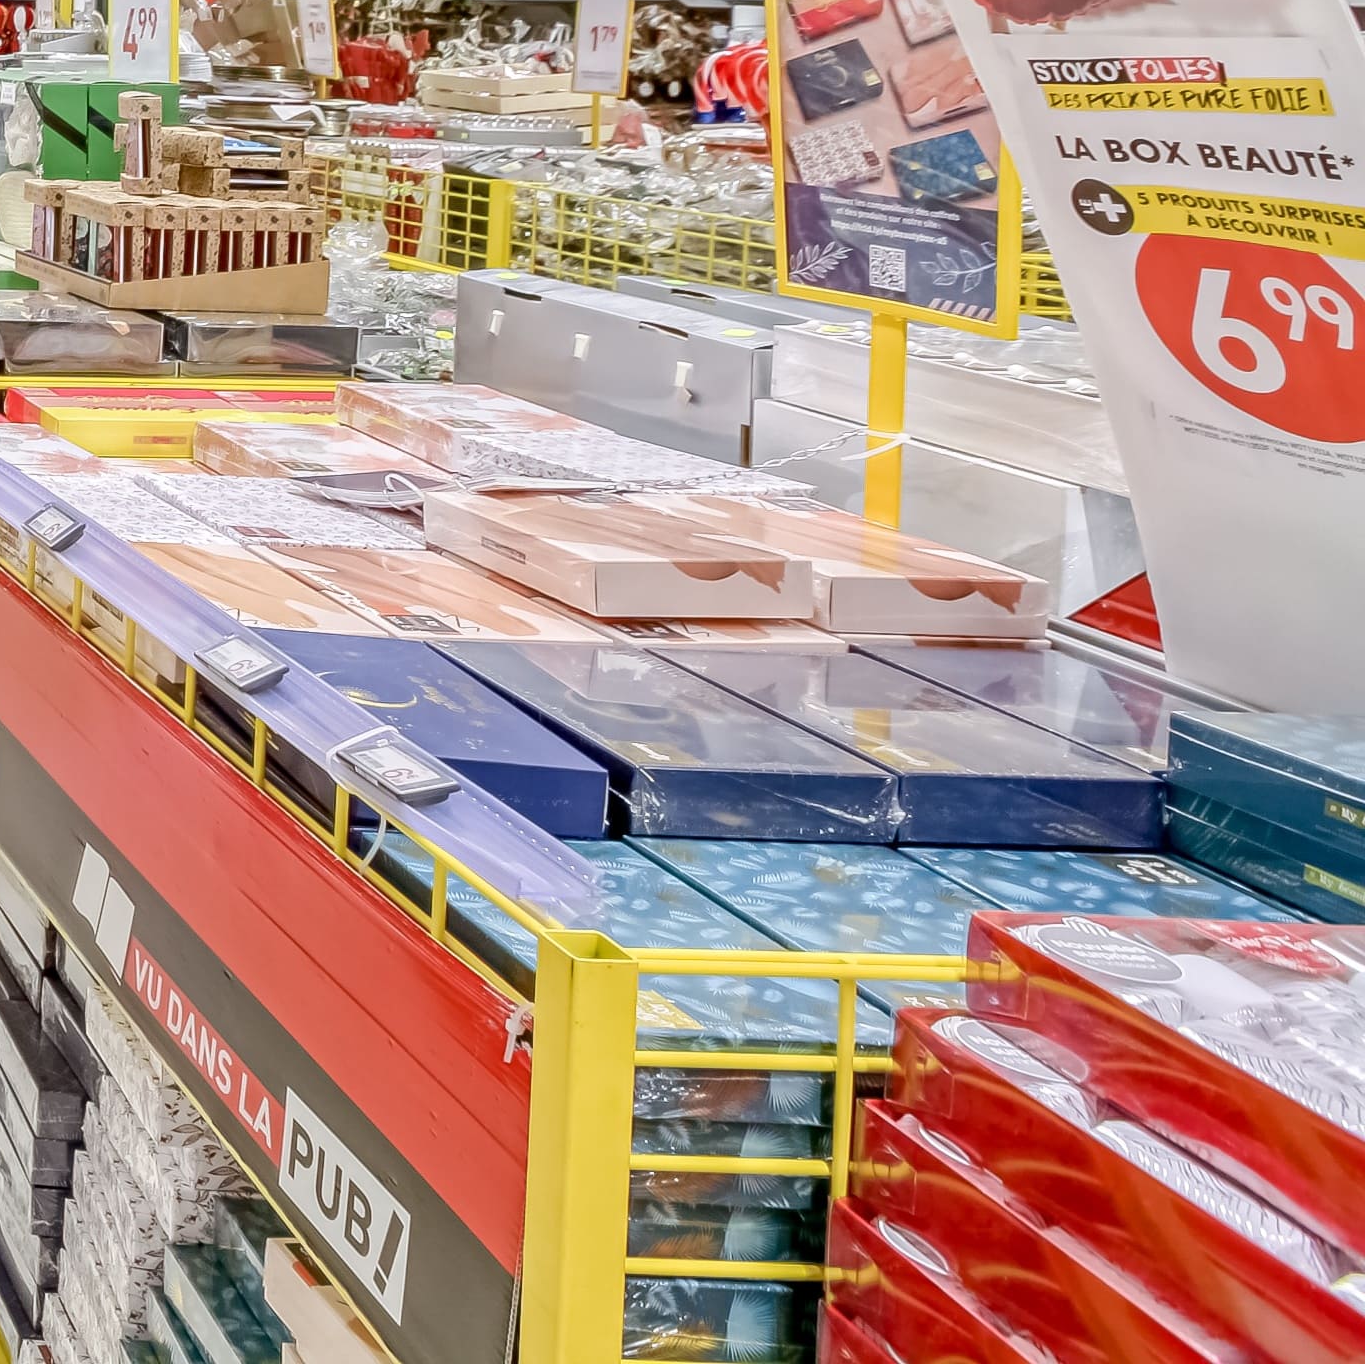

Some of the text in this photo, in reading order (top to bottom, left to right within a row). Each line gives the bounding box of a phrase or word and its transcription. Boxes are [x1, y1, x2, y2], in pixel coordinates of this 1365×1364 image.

[1049, 87, 1310, 112] DES PRIX DE PURE FOLIE
[1055, 135, 1097, 161] LA
[1103, 139, 1190, 167] BOX
[1137, 192, 1365, 229] 5 PRODUITS SURPRISES
[1187, 214, 1318, 244] À DÉCOUVRIR
[134, 948, 405, 1296] VU DANS LA PUB!
